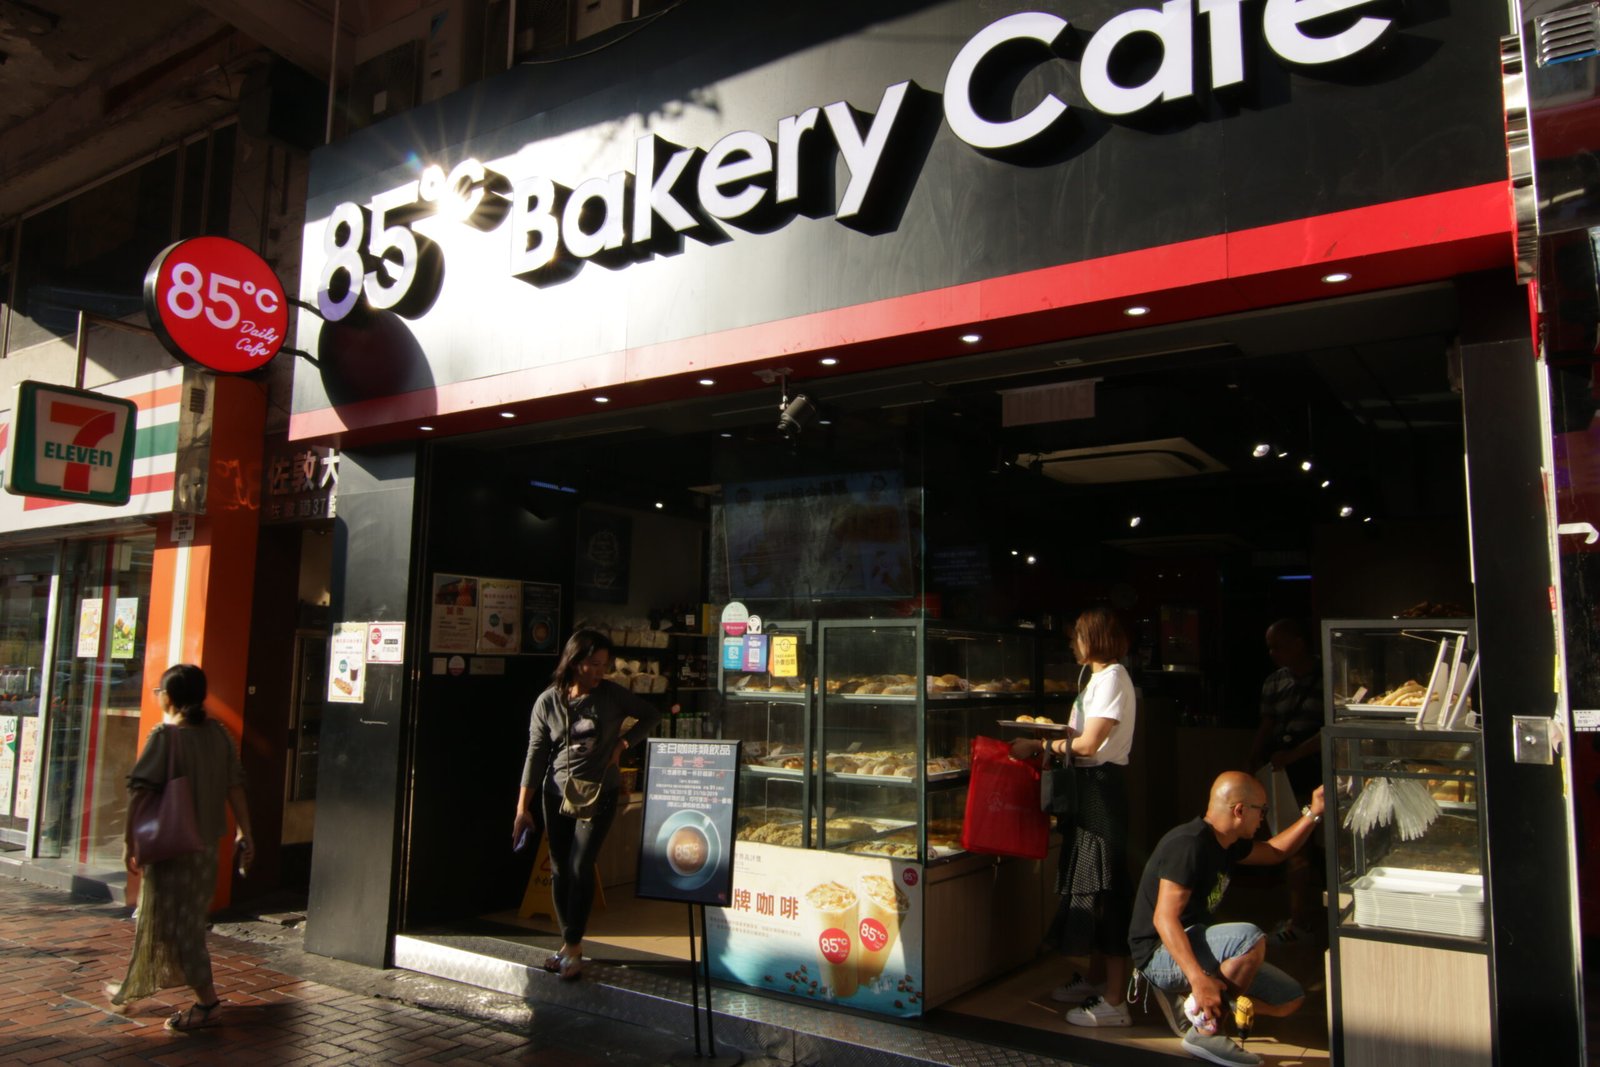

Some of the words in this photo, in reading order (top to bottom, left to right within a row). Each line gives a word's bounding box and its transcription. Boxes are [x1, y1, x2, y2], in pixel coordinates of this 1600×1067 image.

[511, 79, 912, 277] Bakery
[167, 262, 279, 330] 85°C
[240, 320, 279, 344] Daily
[235, 338, 270, 357] Cafe
[656, 743, 731, 756] 全日咖啡類飲品
[733, 887, 800, 921] 牌咖啡
[860, 922, 886, 941] 85°C
[820, 937, 848, 953] 85°C
